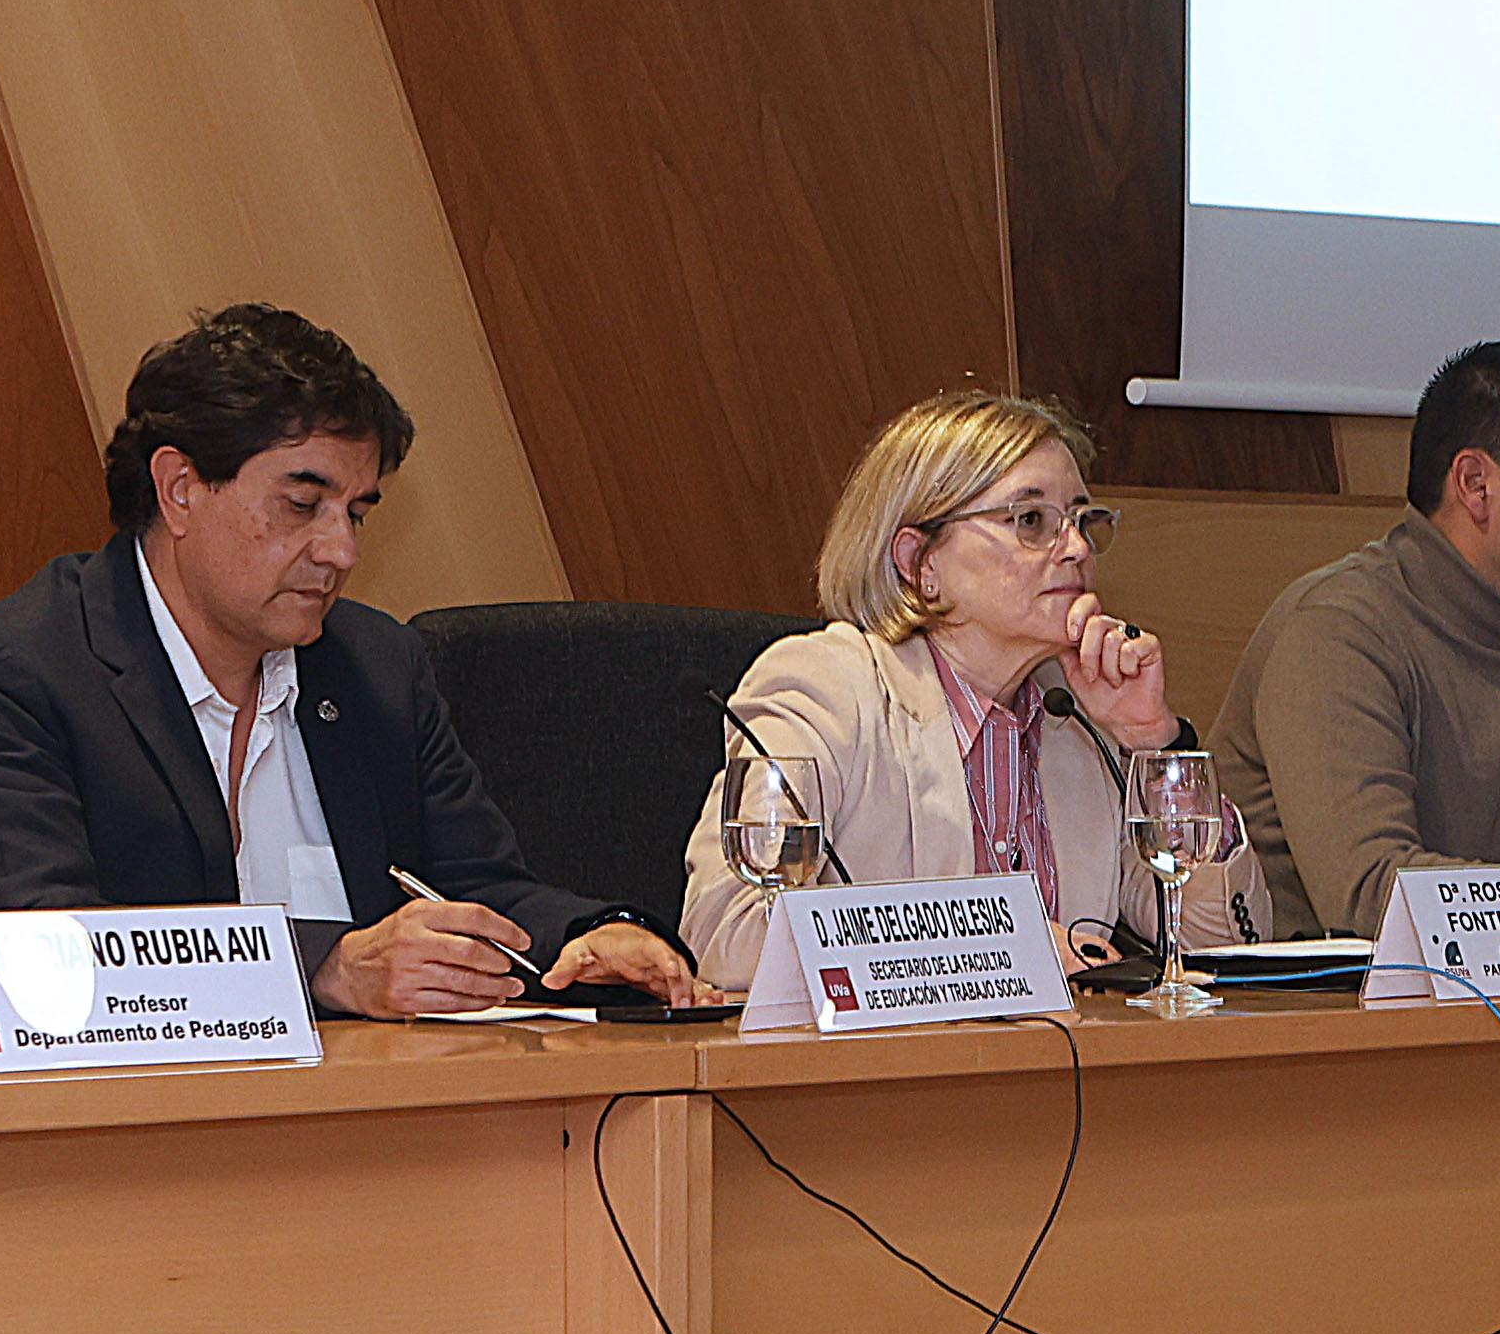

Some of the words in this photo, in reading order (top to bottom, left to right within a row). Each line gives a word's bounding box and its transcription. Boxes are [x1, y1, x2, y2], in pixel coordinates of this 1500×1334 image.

[811, 908, 835, 949] D.
[835, 905, 880, 948] JAIME
[879, 901, 949, 944] DELGADO
[949, 895, 1016, 937] IGLESIAS
[130, 926, 223, 966] RUBIA
[227, 924, 272, 963] AVI
[868, 955, 933, 982] SECRETARIO
[933, 955, 949, 975] DE
[948, 954, 963, 974] LA
[962, 950, 1012, 973] FACULTAD
[105, 994, 190, 1015] Profesor
[828, 982, 851, 998] UVa
[864, 989, 881, 1011] DE
[881, 979, 939, 1010] EDUCACIÓN
[938, 984, 949, 1003] Y
[947, 979, 996, 1003] TRABAJO
[996, 974, 1034, 999] SOCIAL
[161, 1022, 186, 1042] de
[189, 1014, 289, 1043] Pedagogía
